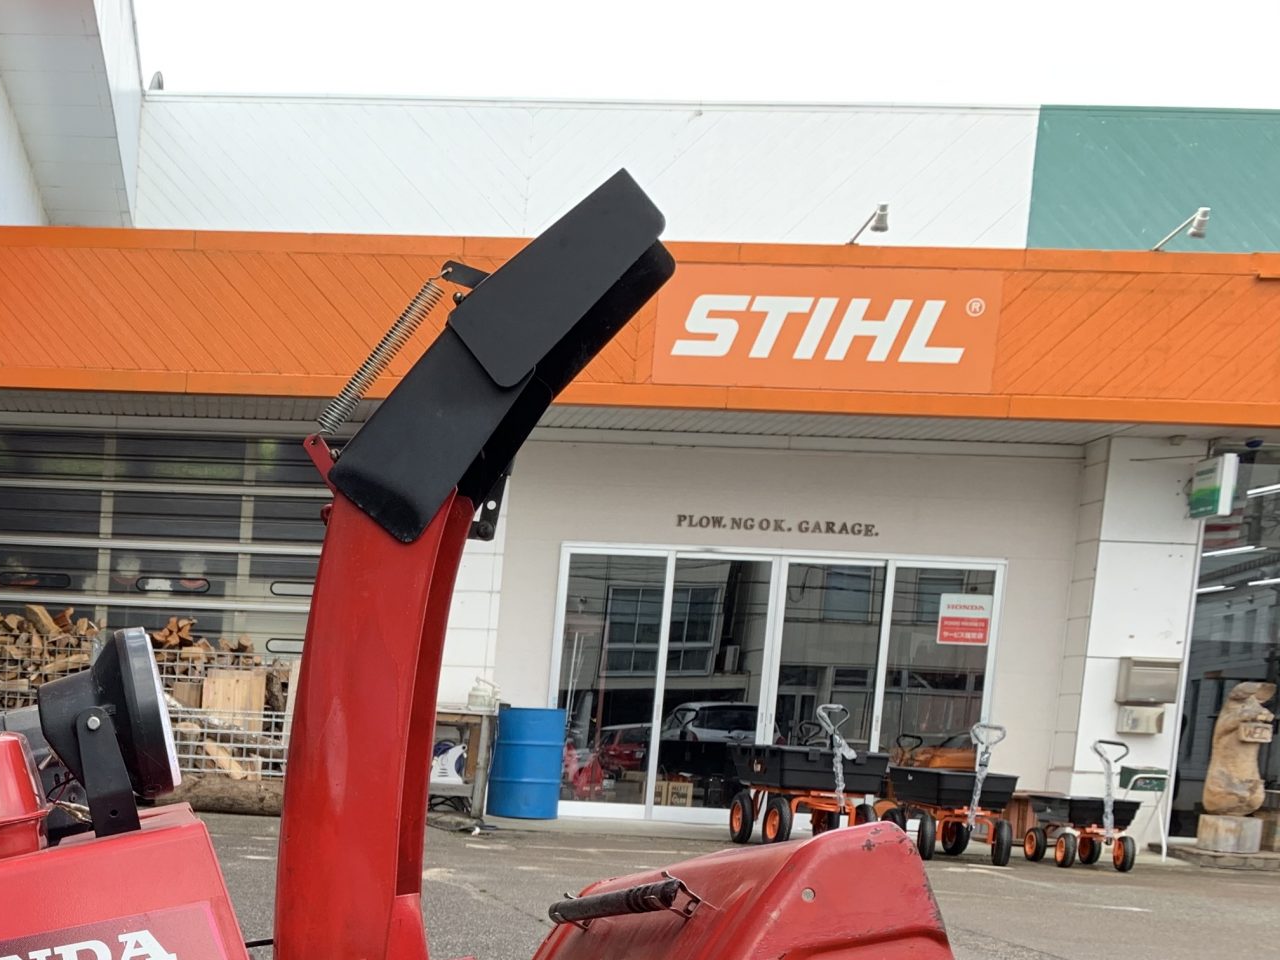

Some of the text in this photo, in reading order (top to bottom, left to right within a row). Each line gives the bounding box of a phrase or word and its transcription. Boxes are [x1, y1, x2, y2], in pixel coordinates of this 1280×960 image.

[670, 294, 965, 364] STIHL
[676, 514, 726, 529] PLOW.
[798, 520, 879, 537] GARAGE.
